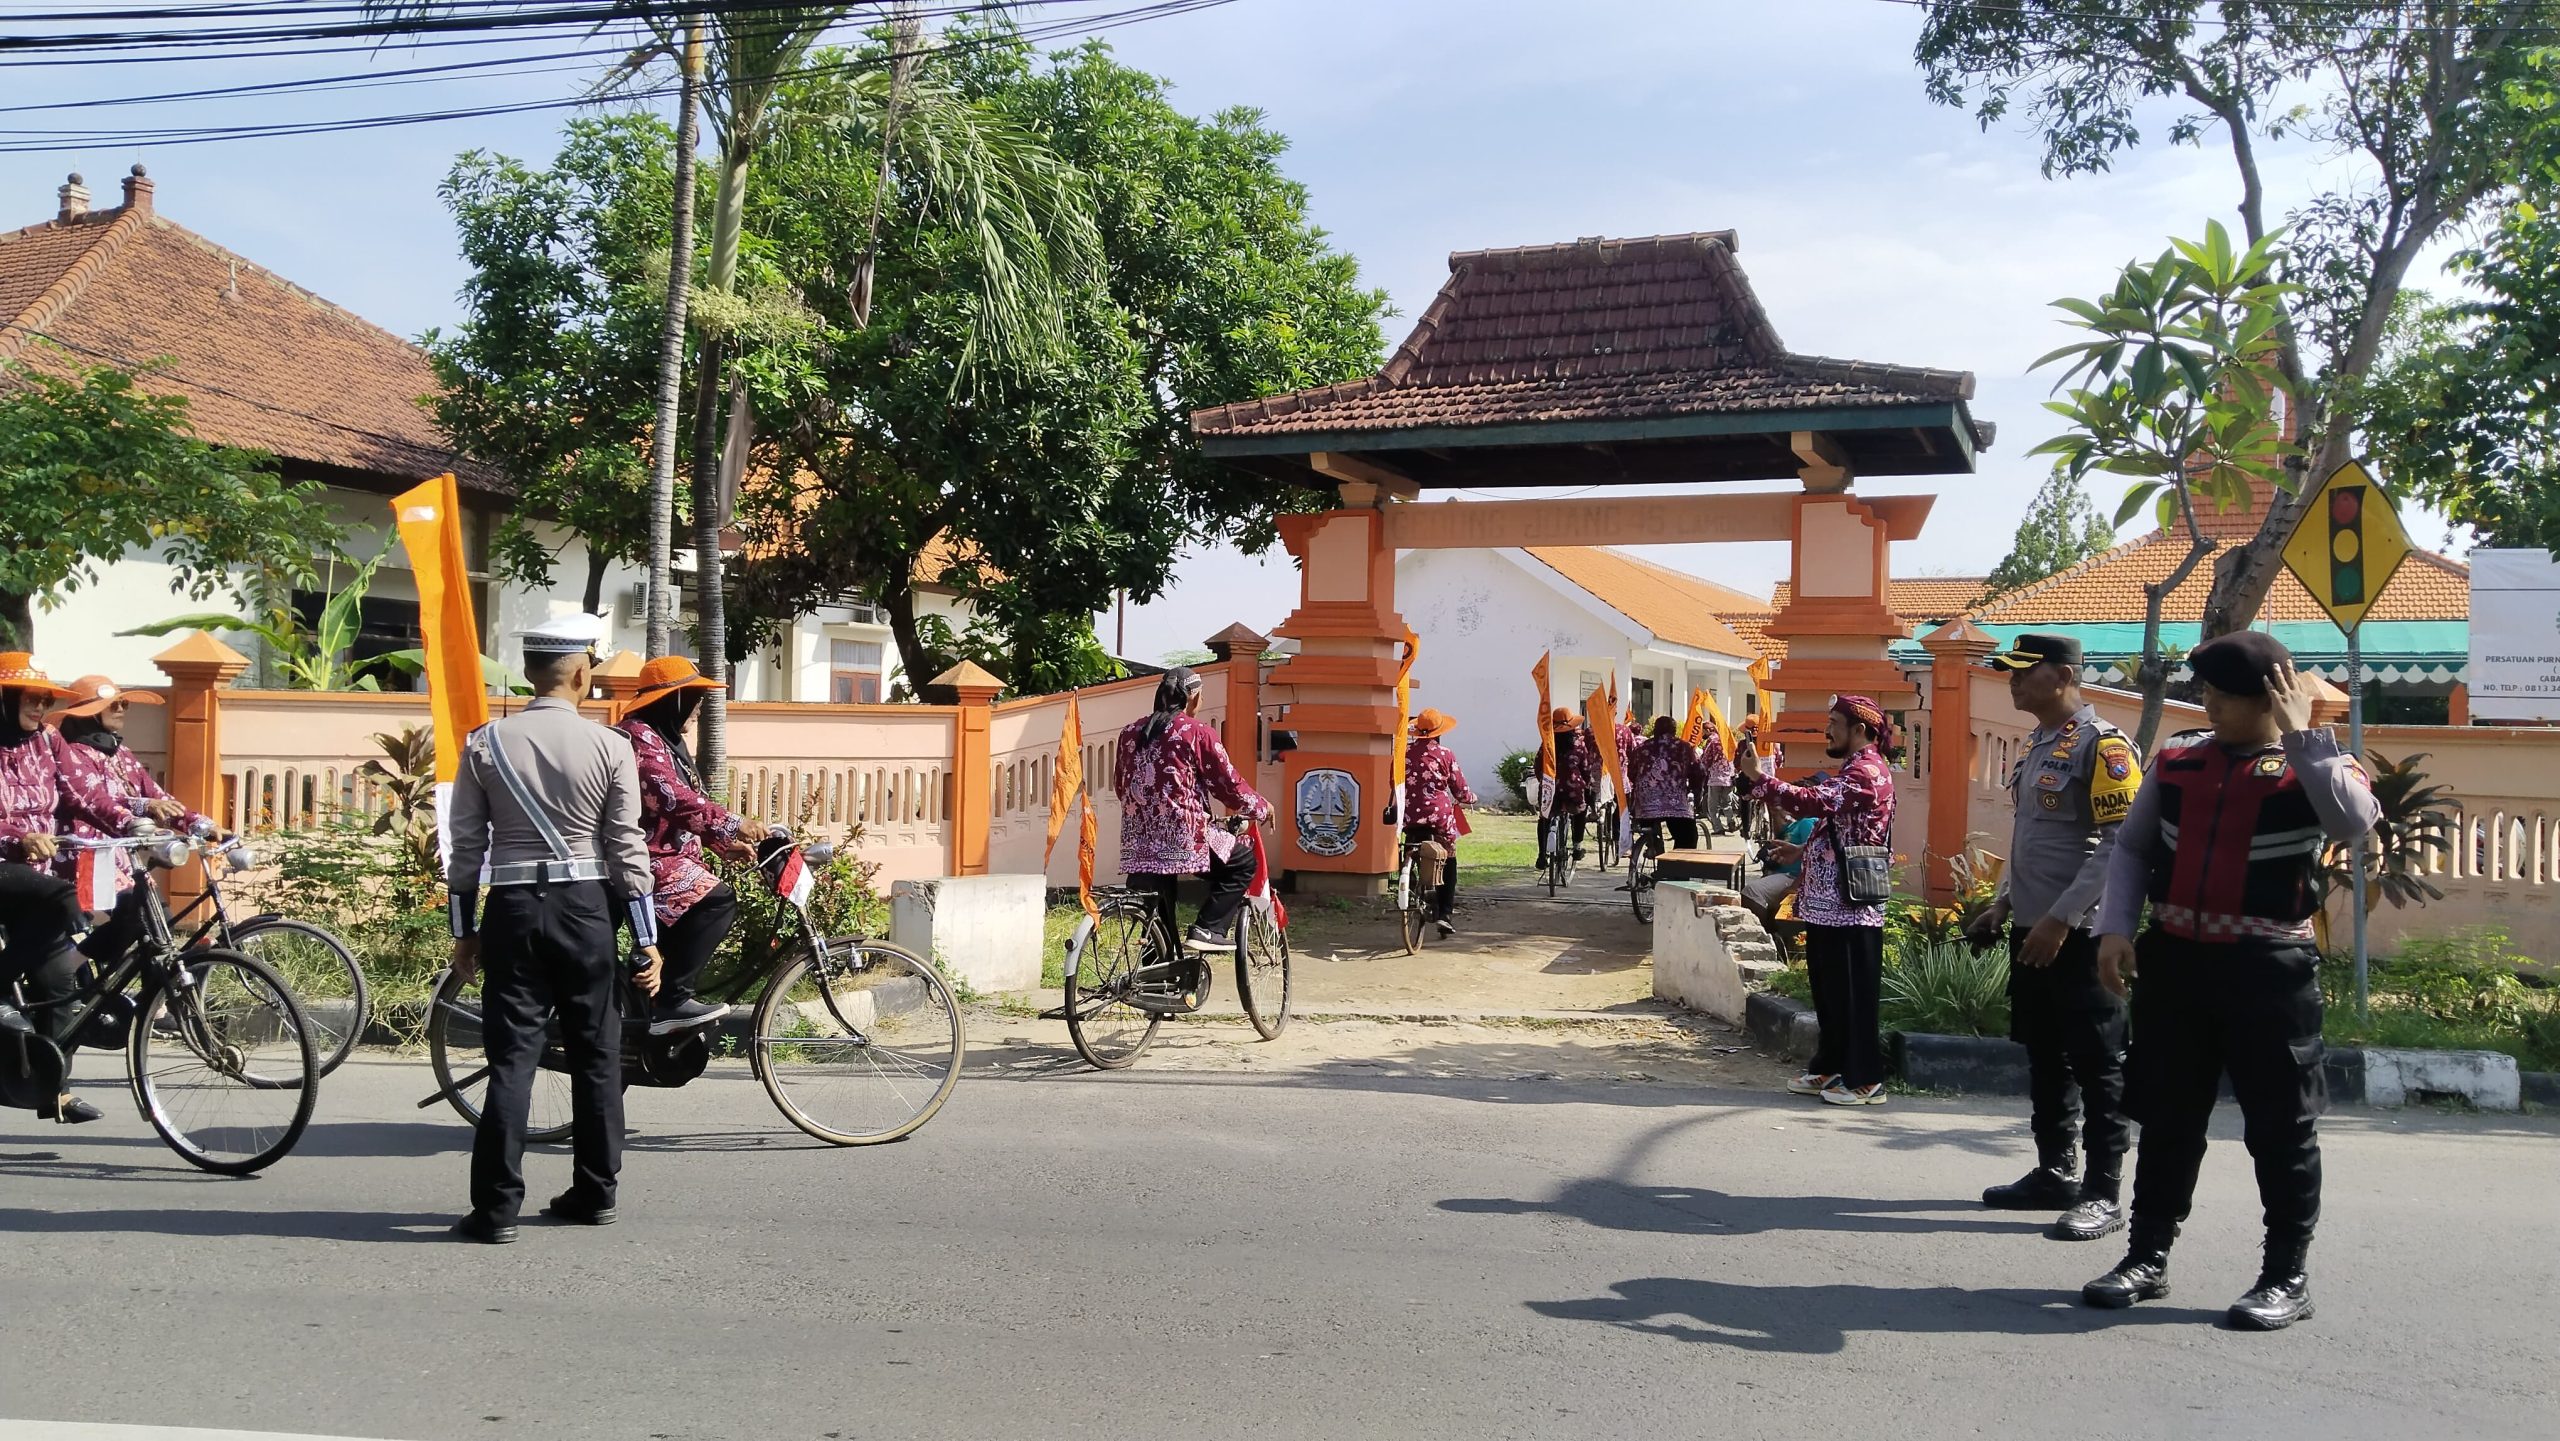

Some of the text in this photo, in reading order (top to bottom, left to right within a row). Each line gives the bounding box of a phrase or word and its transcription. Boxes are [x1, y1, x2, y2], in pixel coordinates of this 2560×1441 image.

[2485, 655, 2535, 663] PERSATUAN
[2041, 760, 2074, 772] POLRI
[2093, 790, 2132, 811] PADAL
[2098, 807, 2128, 818] LAMONG
